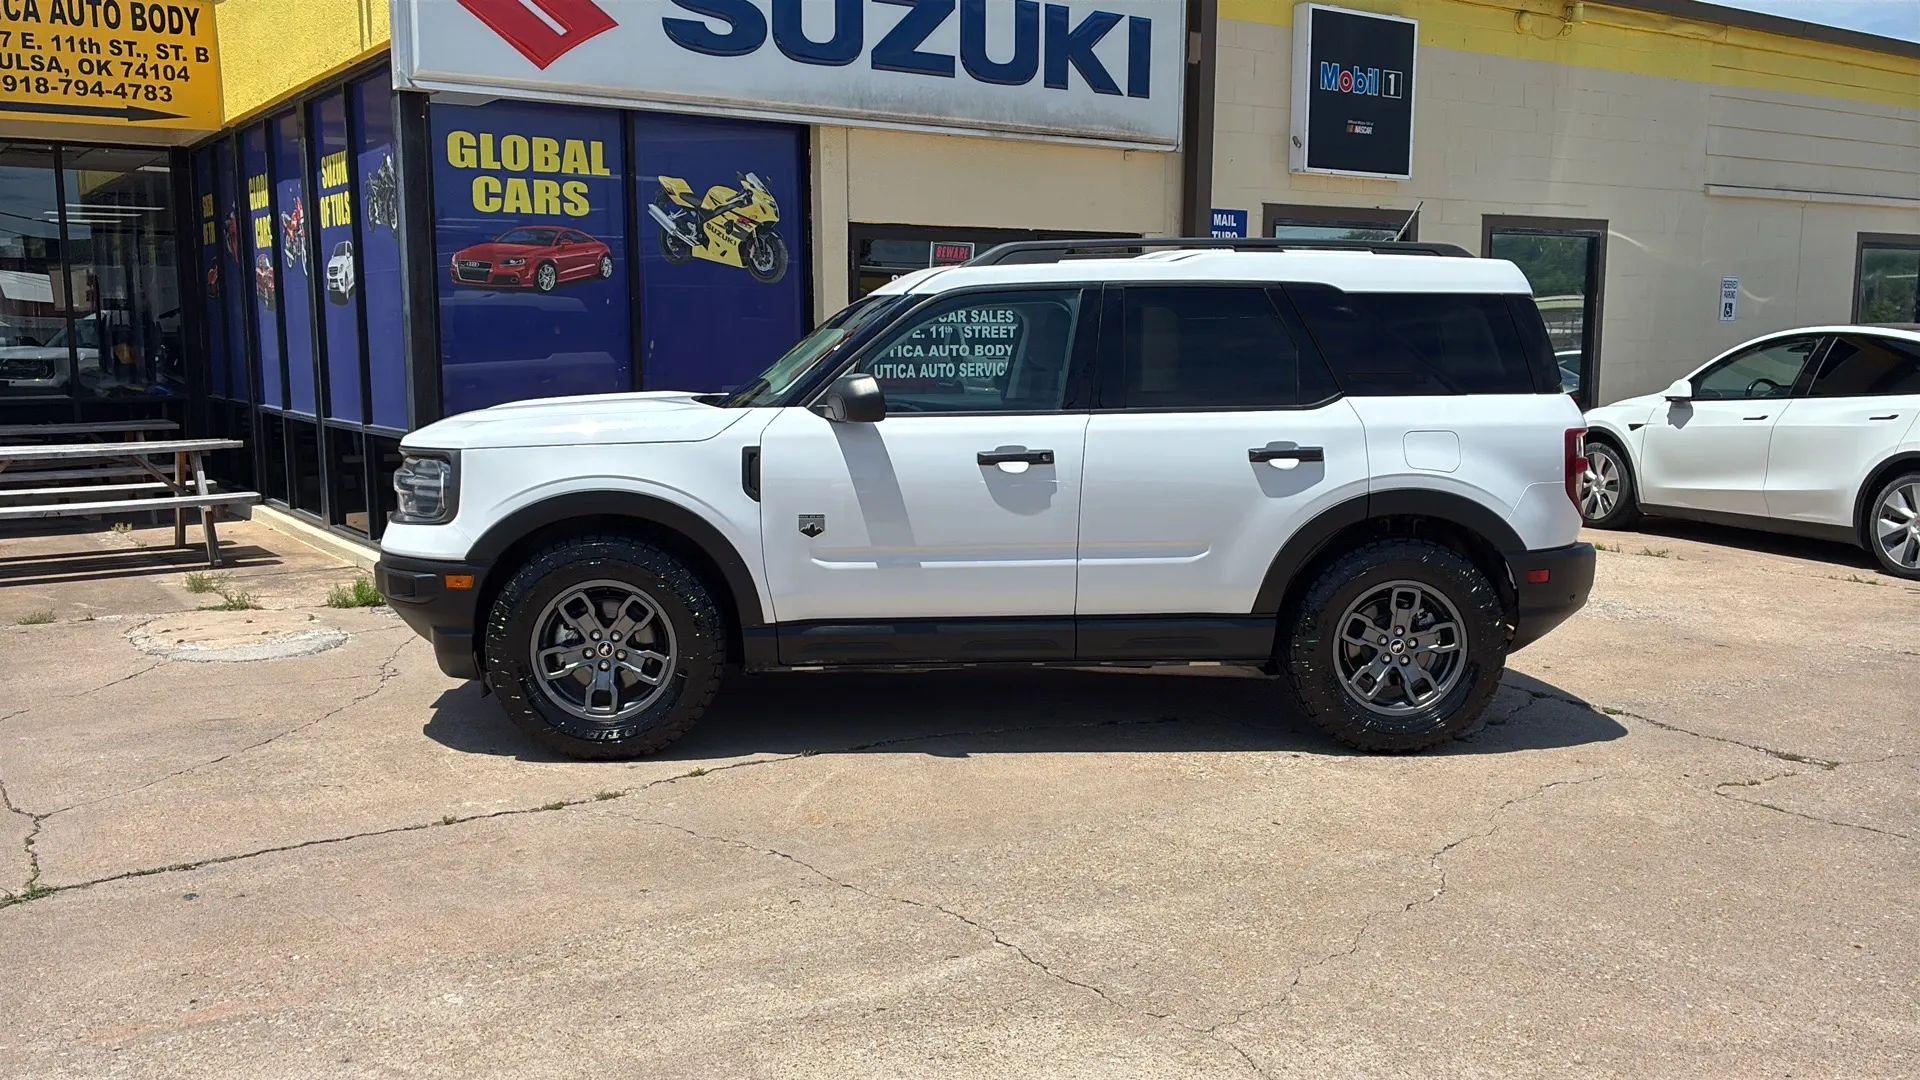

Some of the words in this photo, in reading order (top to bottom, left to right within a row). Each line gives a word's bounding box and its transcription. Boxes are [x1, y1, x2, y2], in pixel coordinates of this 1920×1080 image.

[0, 0, 41, 23] CA
[50, 0, 121, 29] AUTO
[130, 1, 199, 36] BODY
[21, 32, 42, 50] E.
[51, 35, 100, 54] 11th
[109, 39, 148, 62] ST.,
[156, 43, 187, 61] ST.
[196, 47, 209, 63] B
[662, 0, 1152, 99] SUZUKI
[78, 58, 113, 77] OK
[121, 61, 190, 82] 74104
[1320, 61, 1379, 96] Mobil
[2, 75, 172, 102] 918-794-4783
[447, 130, 610, 176] GLOBAL
[472, 176, 590, 217] CARS
[1213, 213, 1237, 227] MAIL
[706, 222, 737, 246] SUZUKI
[936, 245, 969, 260] BEWARE
[970, 310, 1014, 323] SALES
[930, 325, 953, 339] 11th
[963, 325, 1017, 339] STREET
[928, 345, 969, 357] AUTO
[974, 344, 1014, 357] BODY
[874, 363, 916, 379] UTICA
[920, 363, 955, 378] AUTO
